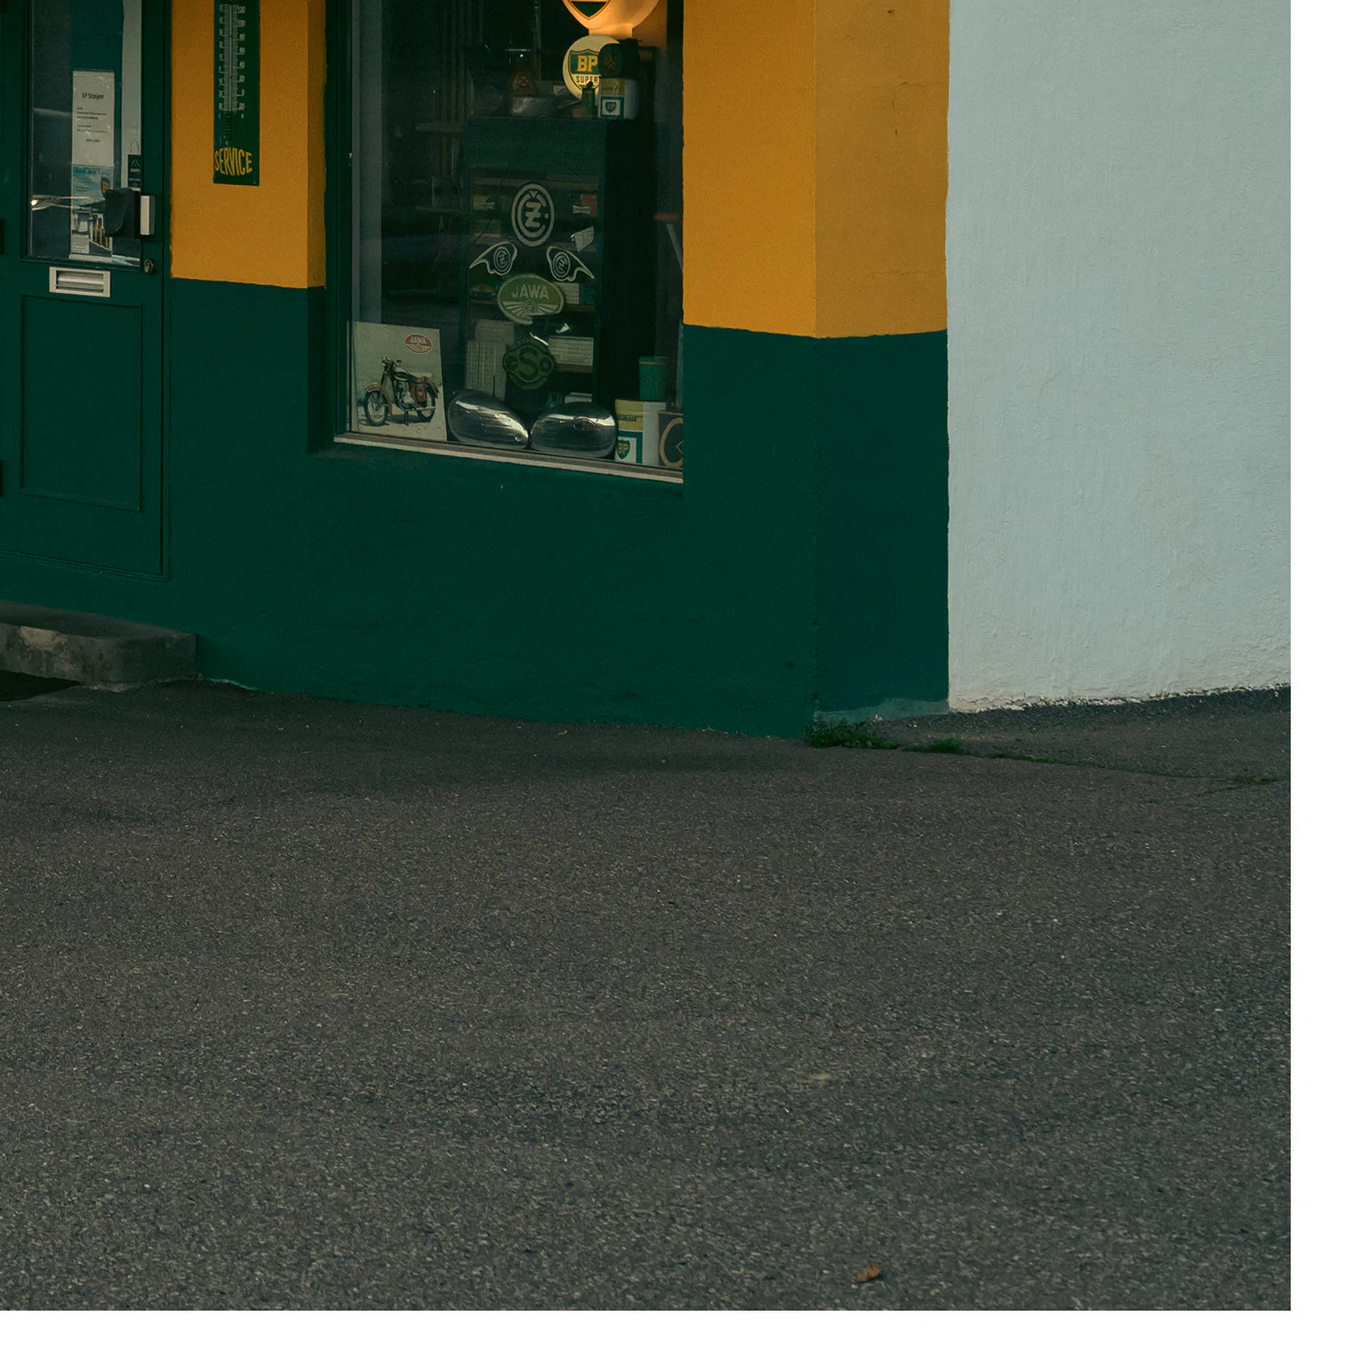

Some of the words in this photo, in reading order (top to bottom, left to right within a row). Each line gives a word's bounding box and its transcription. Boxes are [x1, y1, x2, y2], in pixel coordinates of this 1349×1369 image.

[576, 54, 599, 72] BP
[576, 75, 598, 84] SUPER
[215, 146, 253, 176] SERVICE
[510, 283, 550, 300] JAWA
[617, 441, 630, 456] BP
